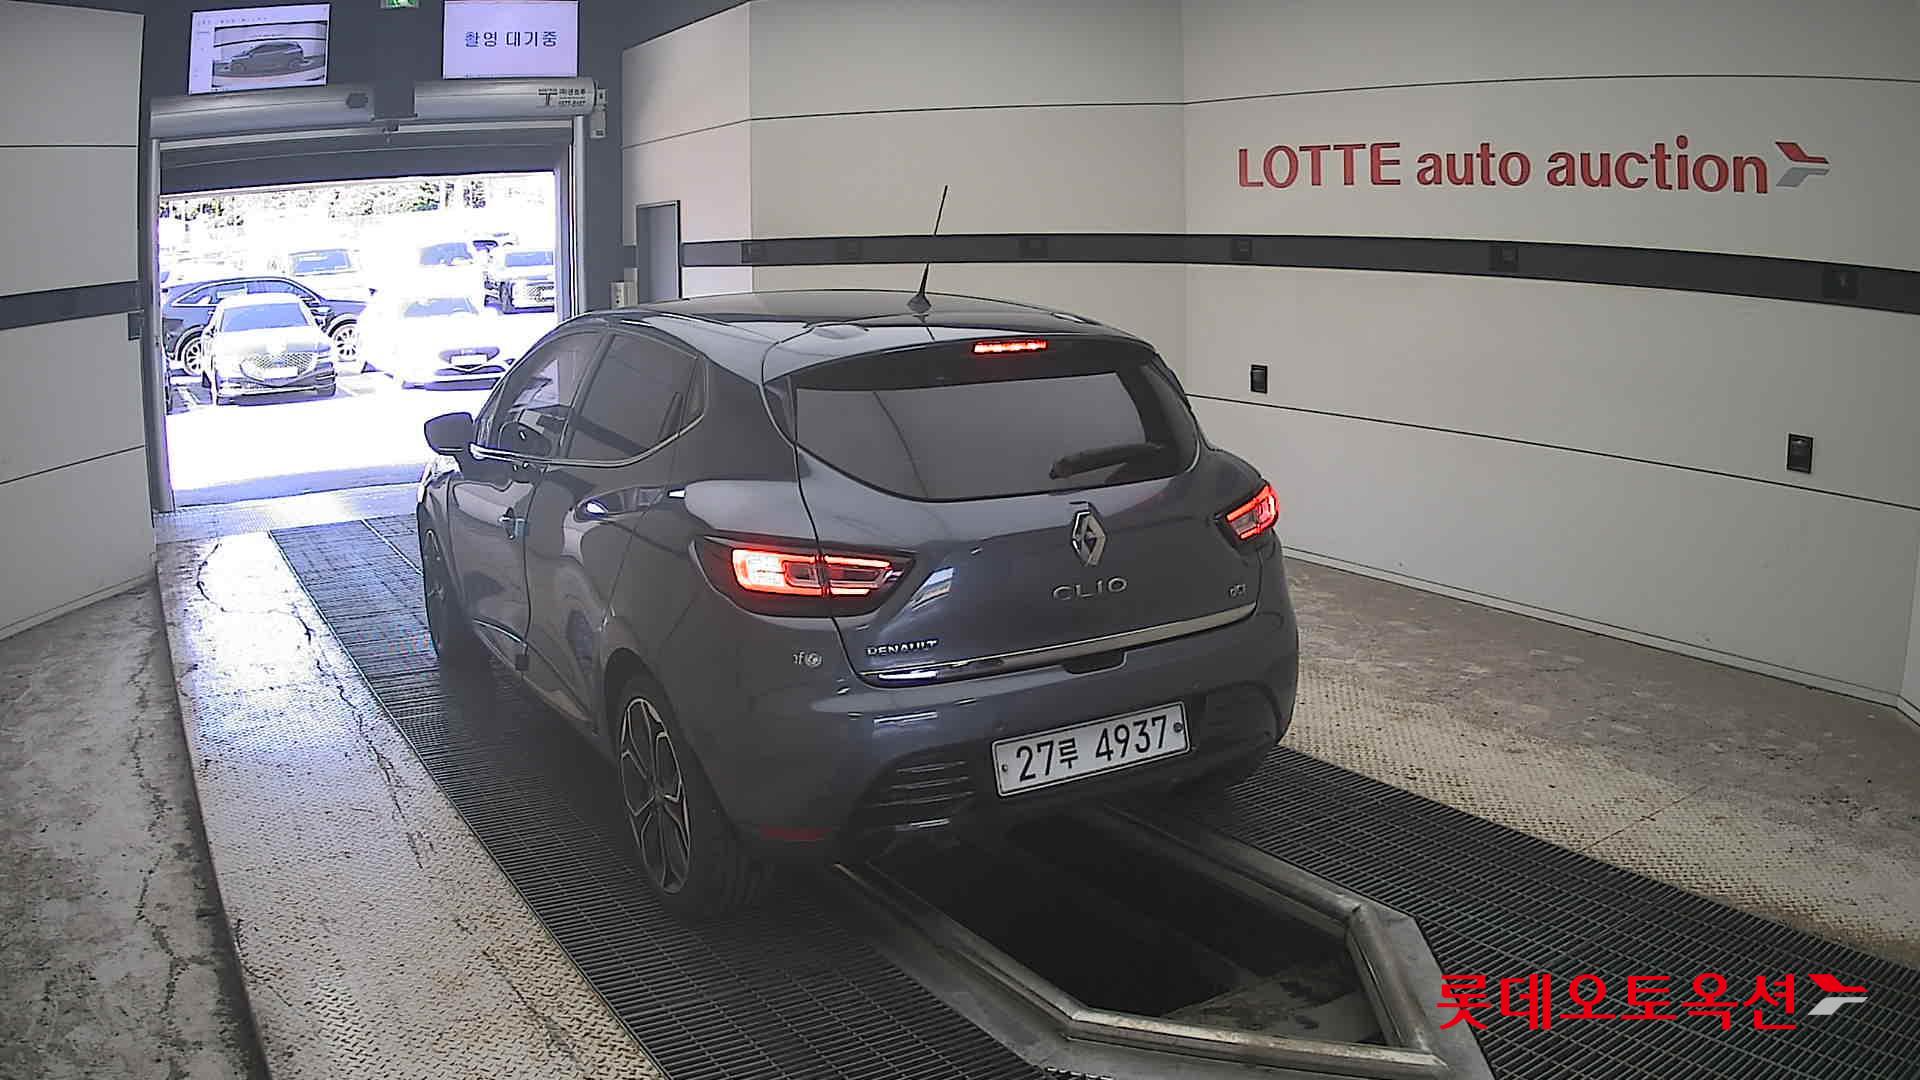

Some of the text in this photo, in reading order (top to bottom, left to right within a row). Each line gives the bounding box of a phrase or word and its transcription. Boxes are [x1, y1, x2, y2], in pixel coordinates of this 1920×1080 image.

[505, 31, 558, 48] 대기중
[1238, 134, 1769, 194] LOTTE auto auction
[1052, 576, 1128, 601] CLIO
[865, 639, 938, 656] RENAULT
[1015, 715, 1167, 782] 27루 4937
